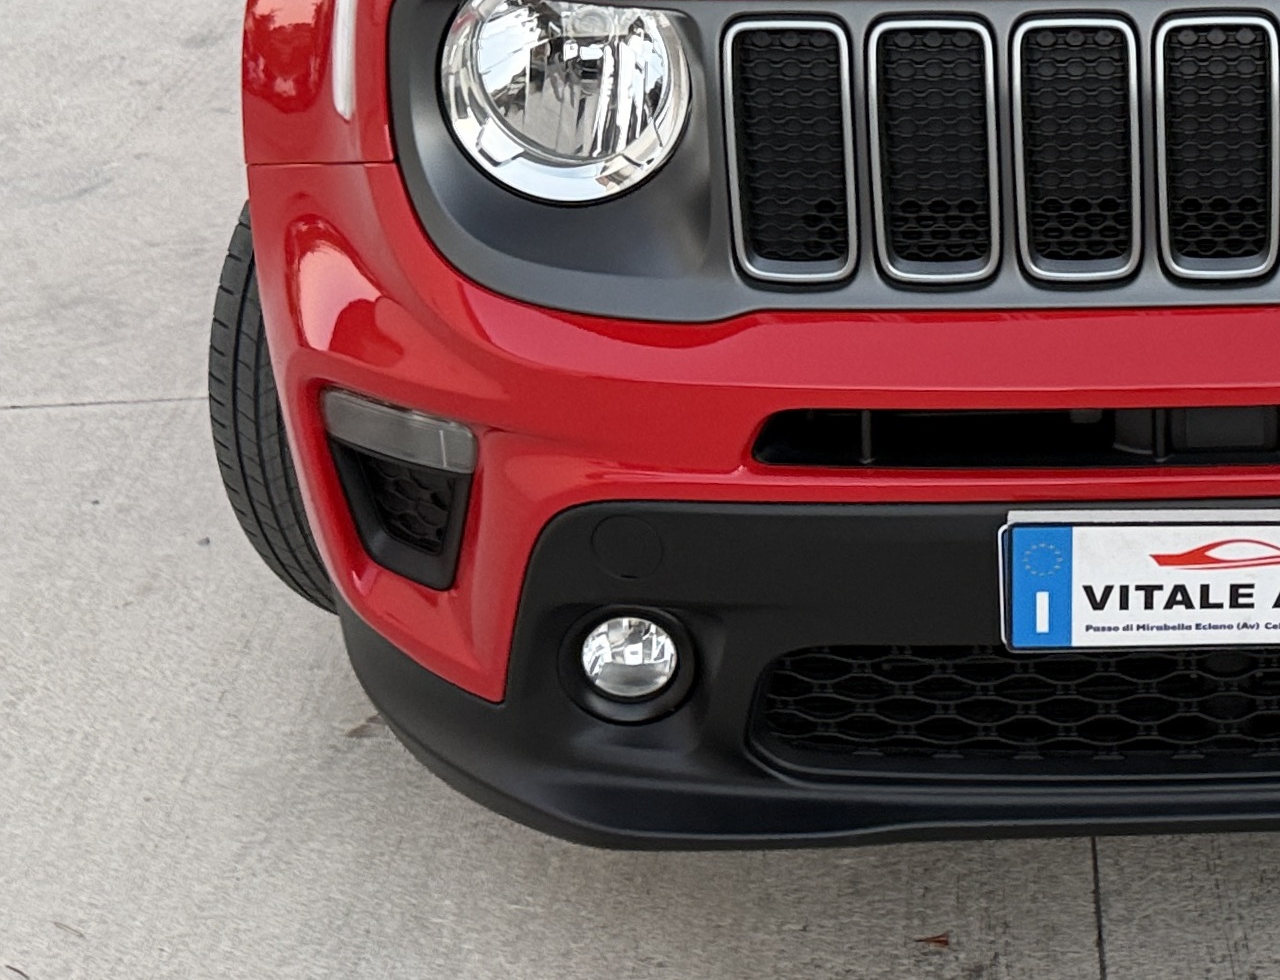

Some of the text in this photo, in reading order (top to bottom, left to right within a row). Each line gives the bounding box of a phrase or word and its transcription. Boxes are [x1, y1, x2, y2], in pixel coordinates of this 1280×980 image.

[1082, 583, 1256, 612] VITALE
[1085, 624, 1120, 633] Passo
[1121, 623, 1134, 632] di
[1136, 622, 1193, 632] Mirabella
[1194, 622, 1234, 631] Eclano
[1236, 621, 1261, 631] (Av)
